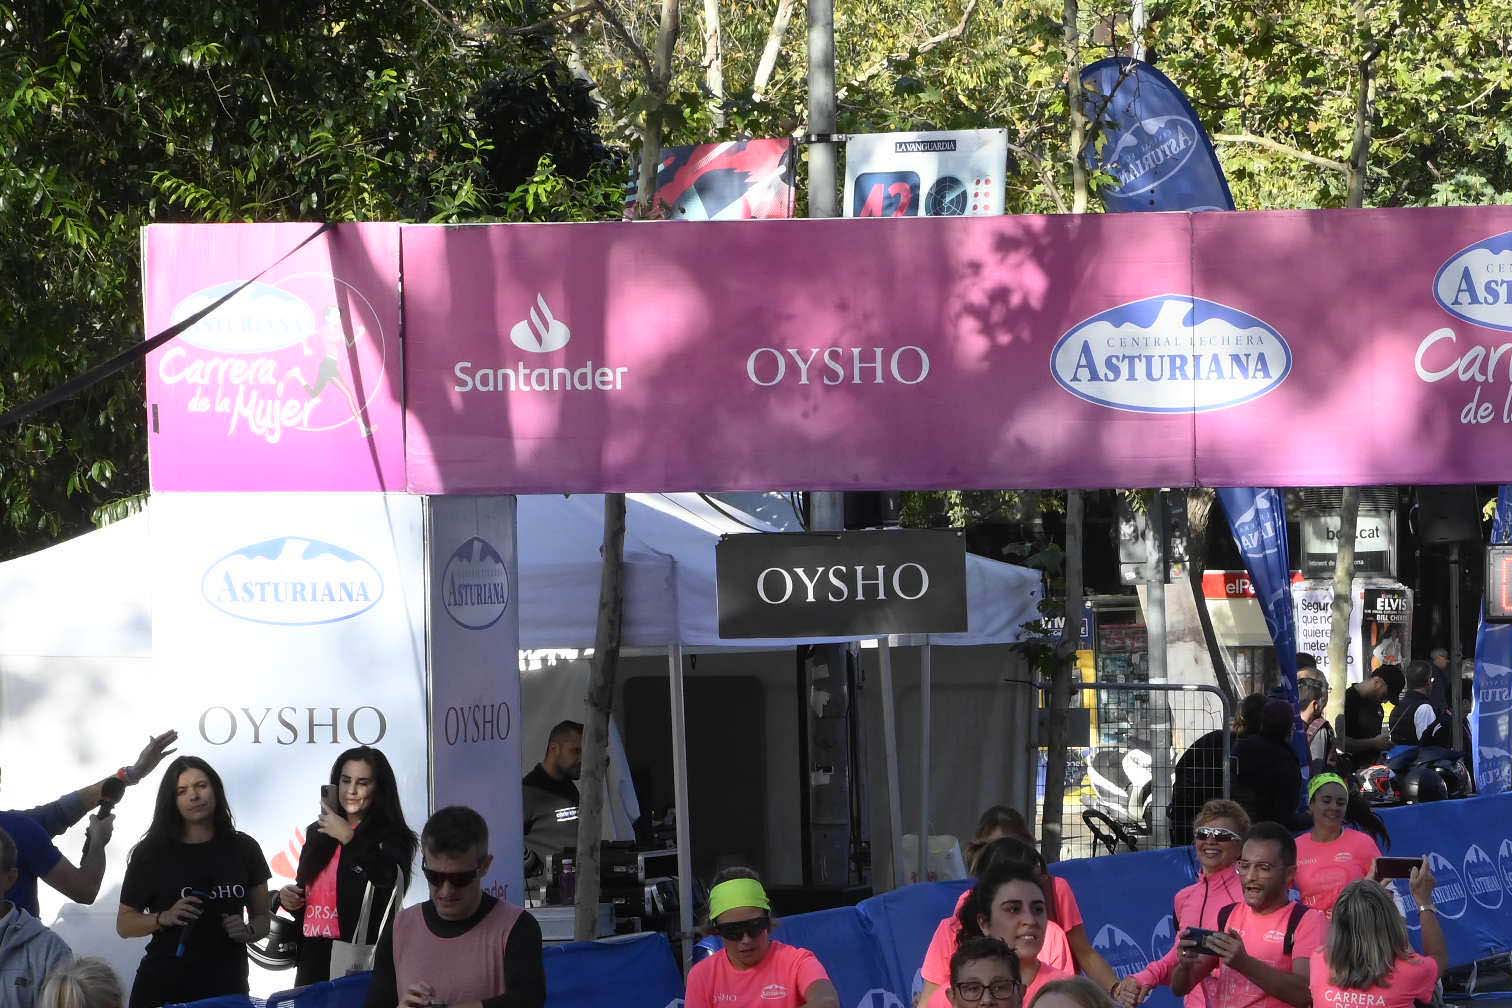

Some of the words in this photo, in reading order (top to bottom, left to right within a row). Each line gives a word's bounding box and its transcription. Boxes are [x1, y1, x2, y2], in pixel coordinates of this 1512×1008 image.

[1069, 336, 1272, 384] ASTURIANA
[1106, 333, 1183, 348] CENTRAL
[1188, 333, 1265, 347] LECHERA
[453, 360, 628, 392] Santander
[745, 344, 931, 387] OYSHO
[1460, 386, 1494, 425] de
[215, 565, 372, 604] ASTURIANA
[447, 568, 506, 608] ASTURIANA
[756, 561, 930, 604] OYSHO
[1377, 597, 1407, 611] ELVIS
[197, 704, 388, 747] OYSHO
[444, 701, 511, 748] OYSHO
[1324, 989, 1386, 1007] CARRERA
